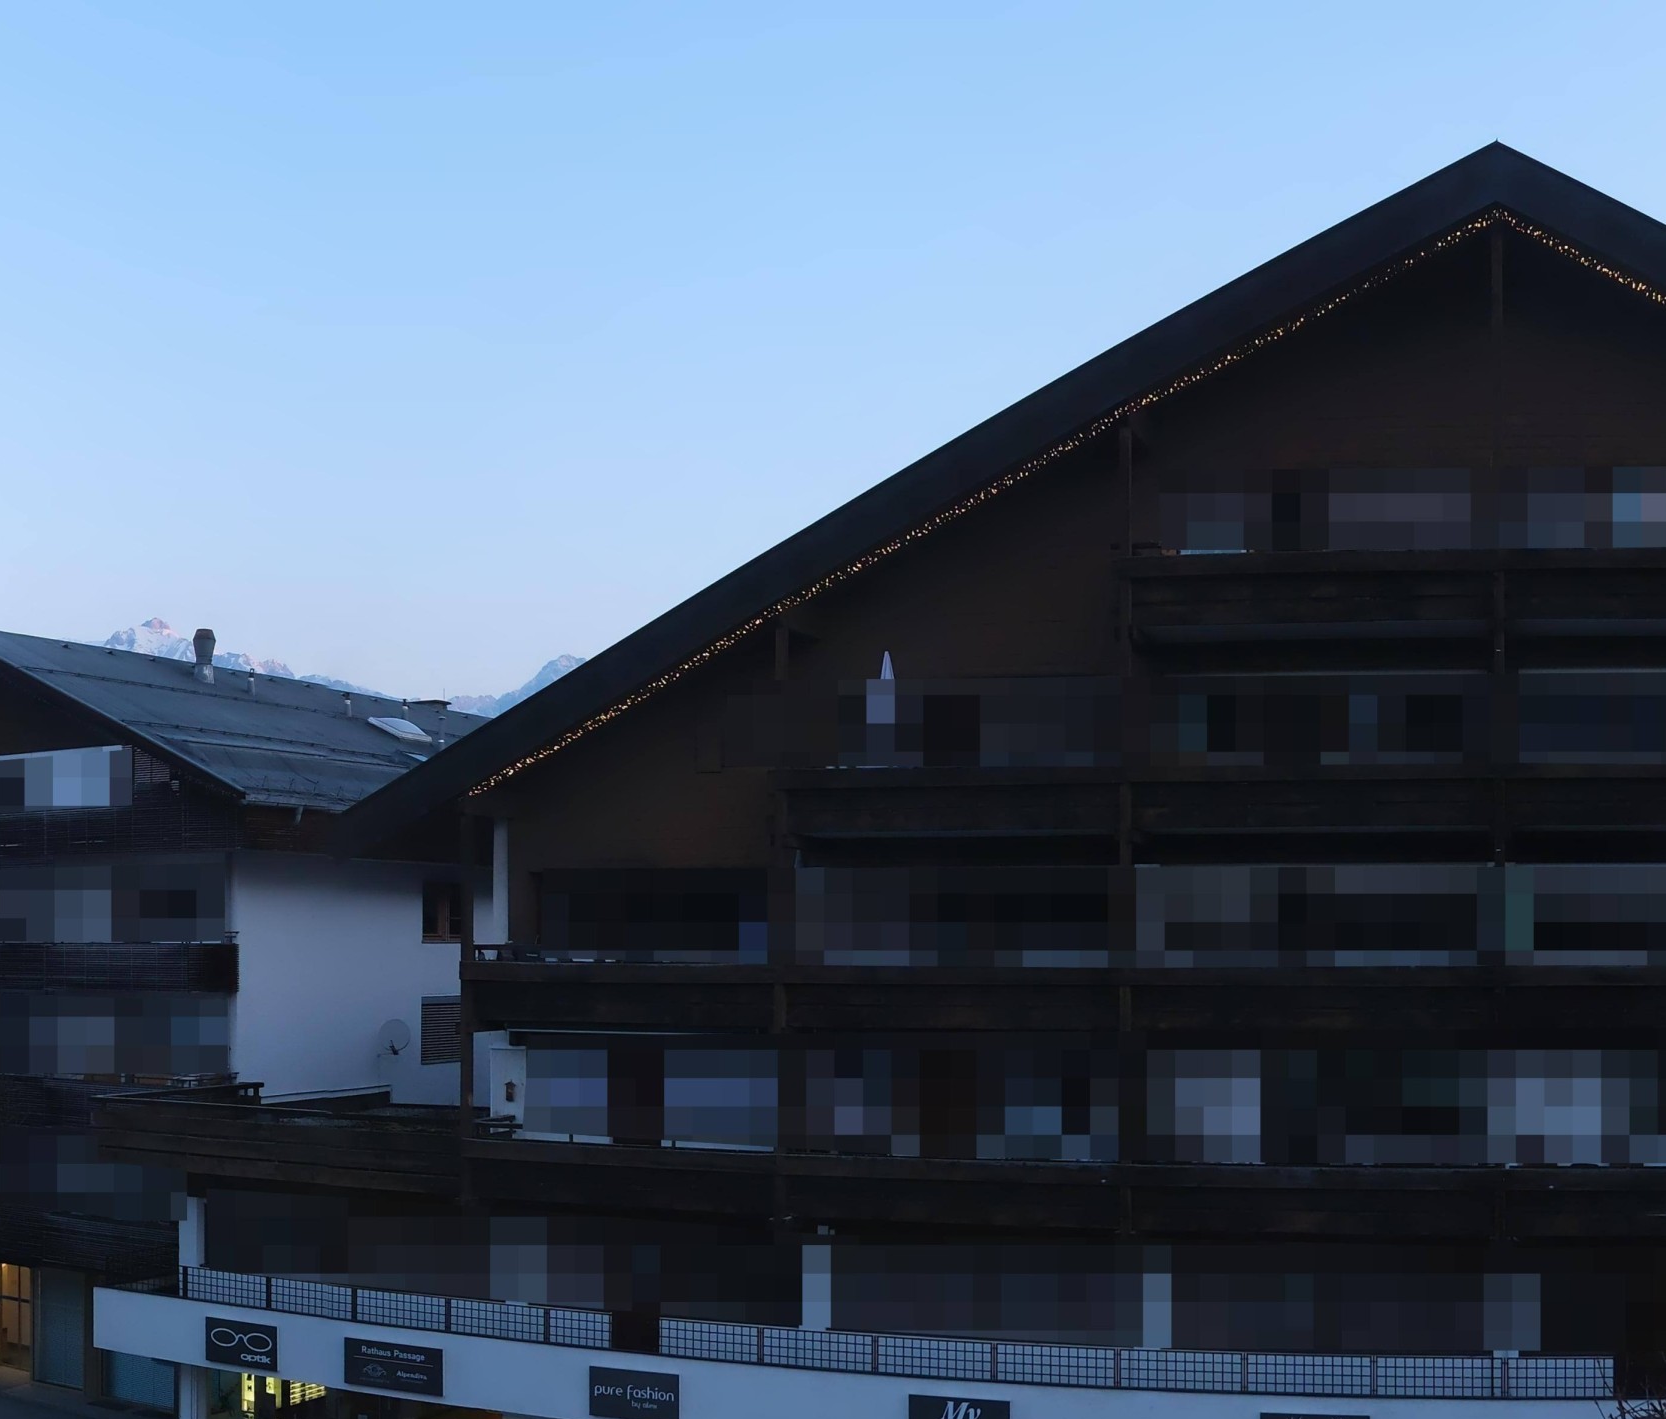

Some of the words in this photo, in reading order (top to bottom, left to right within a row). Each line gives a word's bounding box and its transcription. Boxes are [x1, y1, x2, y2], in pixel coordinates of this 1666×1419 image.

[240, 1353, 271, 1364] optik
[361, 1345, 391, 1357] Rathaus
[393, 1349, 425, 1362] Passage
[594, 1384, 623, 1397] pure
[627, 1384, 674, 1402] fashion
[631, 1400, 641, 1410] by
